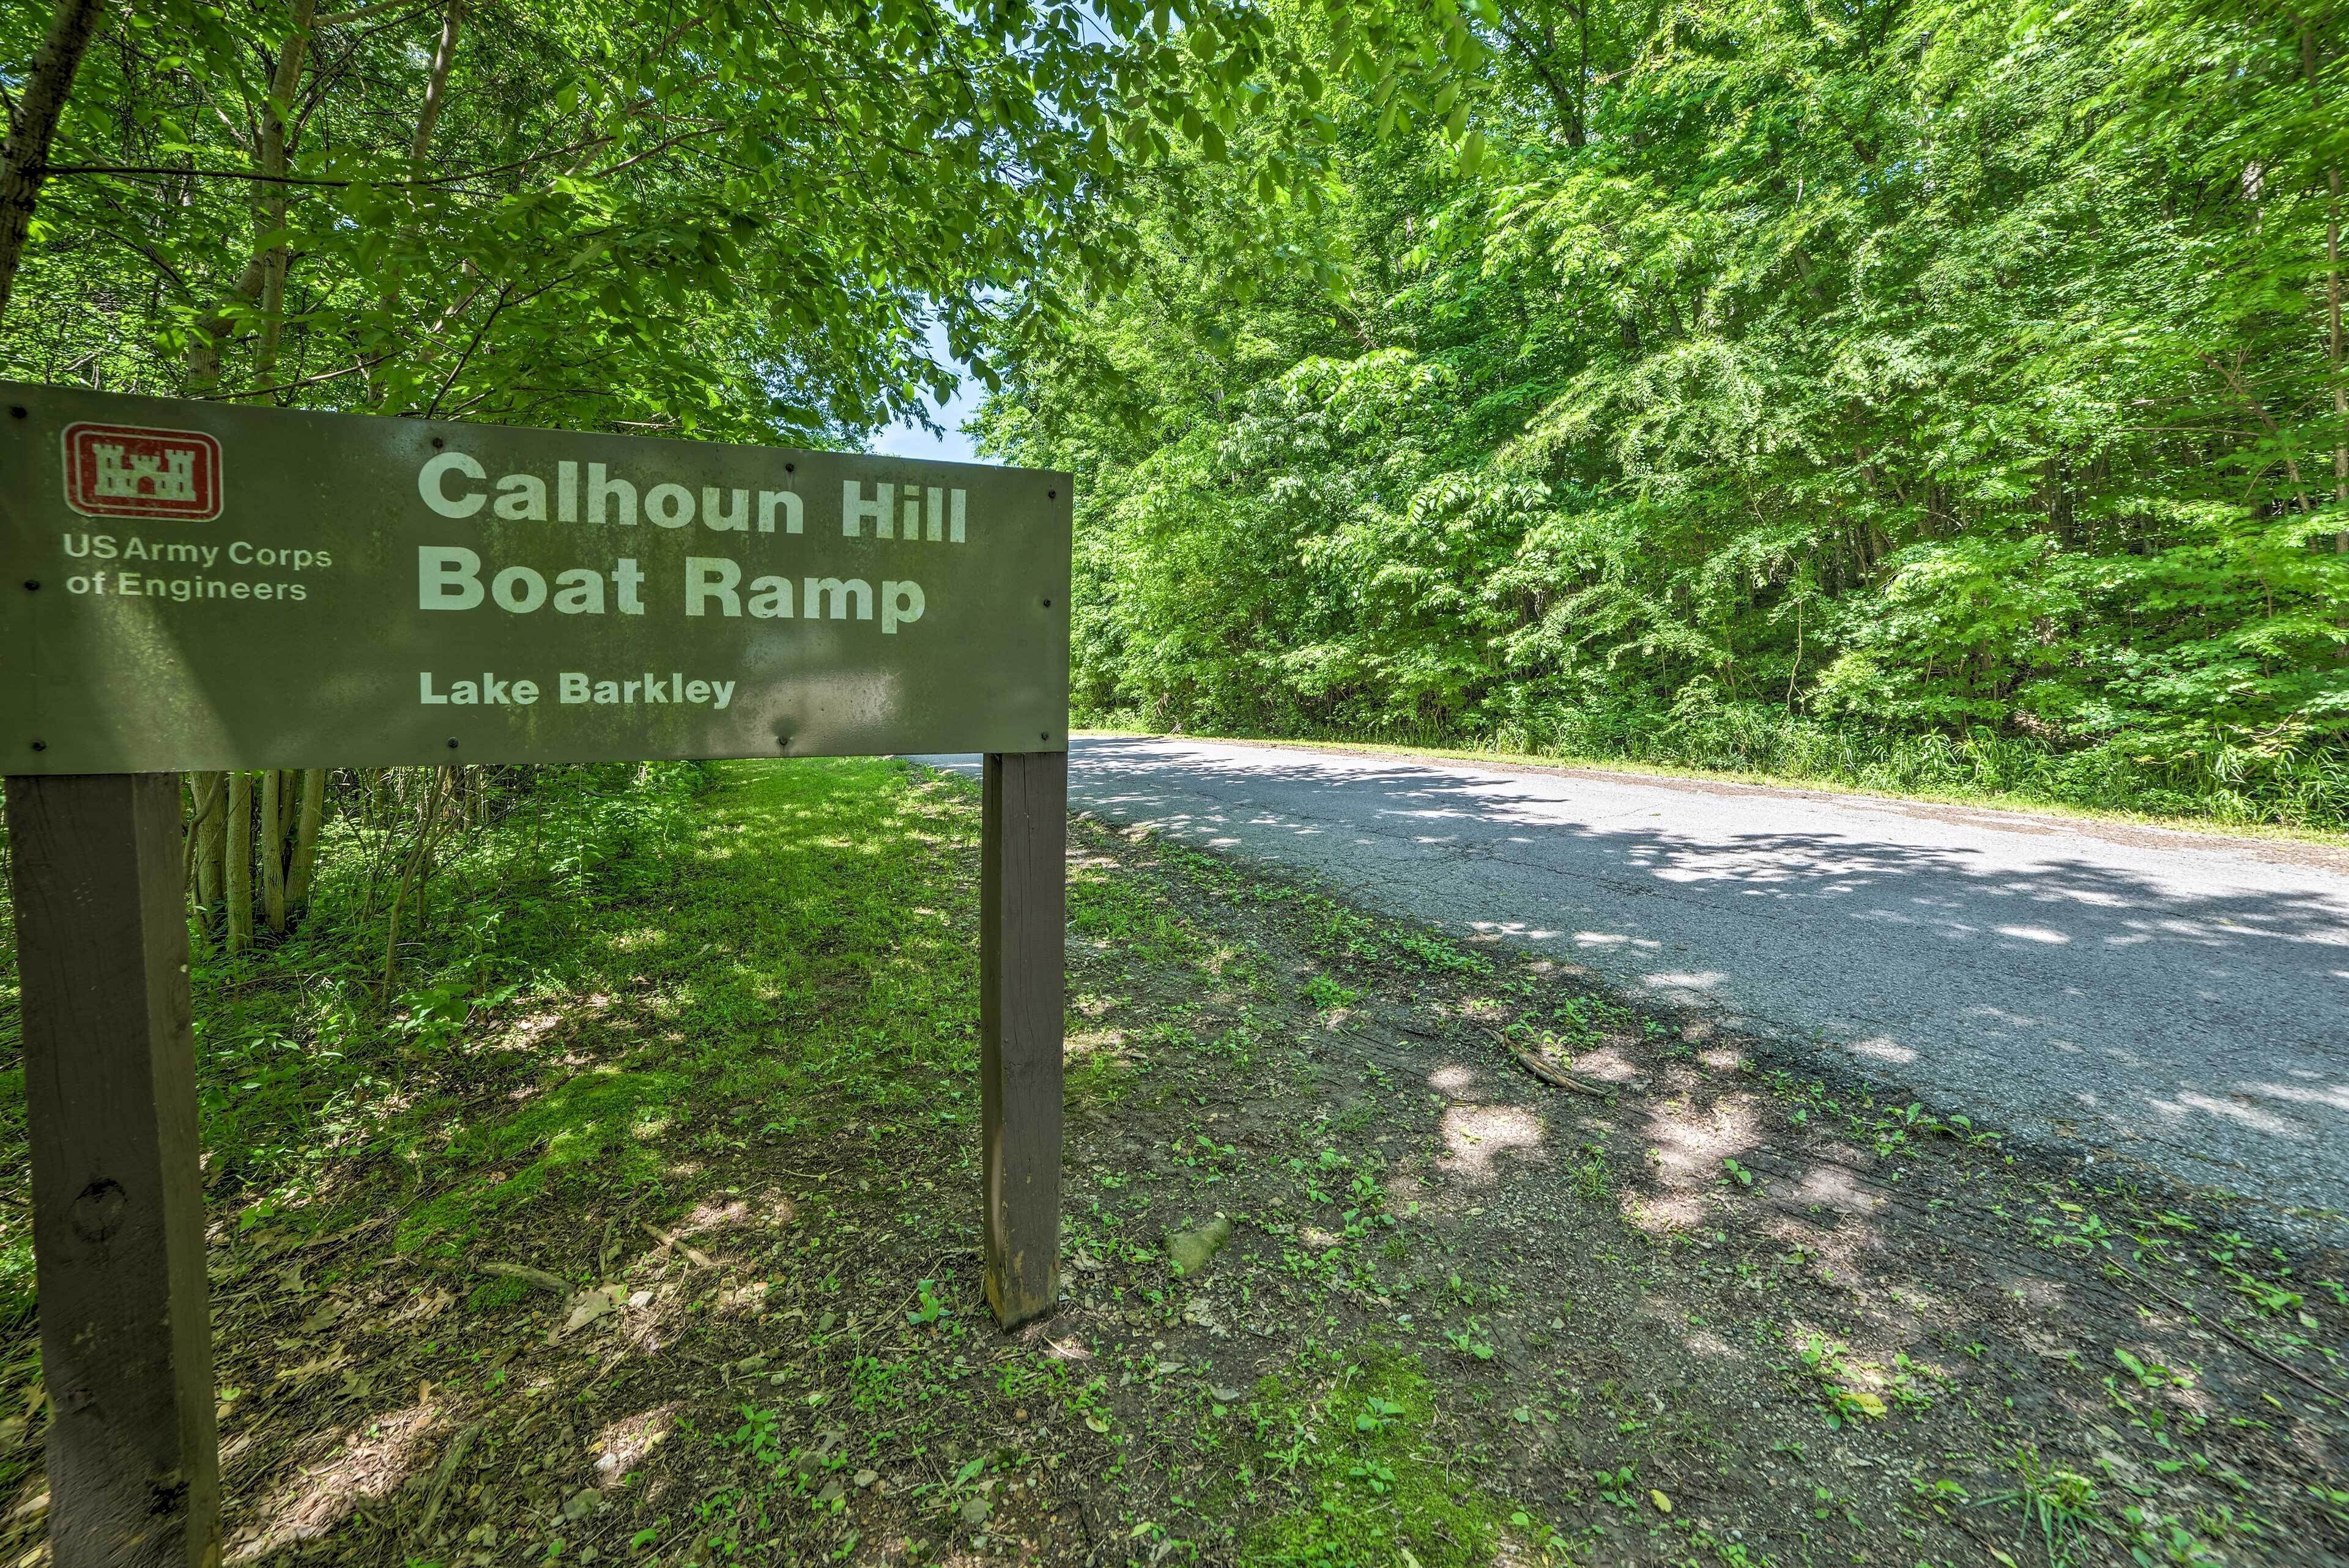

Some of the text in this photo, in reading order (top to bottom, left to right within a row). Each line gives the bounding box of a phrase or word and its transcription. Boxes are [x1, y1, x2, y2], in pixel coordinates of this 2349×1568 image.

[418, 451, 967, 543] Calhoun Hill
[64, 533, 332, 571] US Army Corps
[66, 572, 306, 602] of Engineers
[418, 546, 926, 634] Boat Ramp
[420, 671, 736, 709] Lake Barkley
